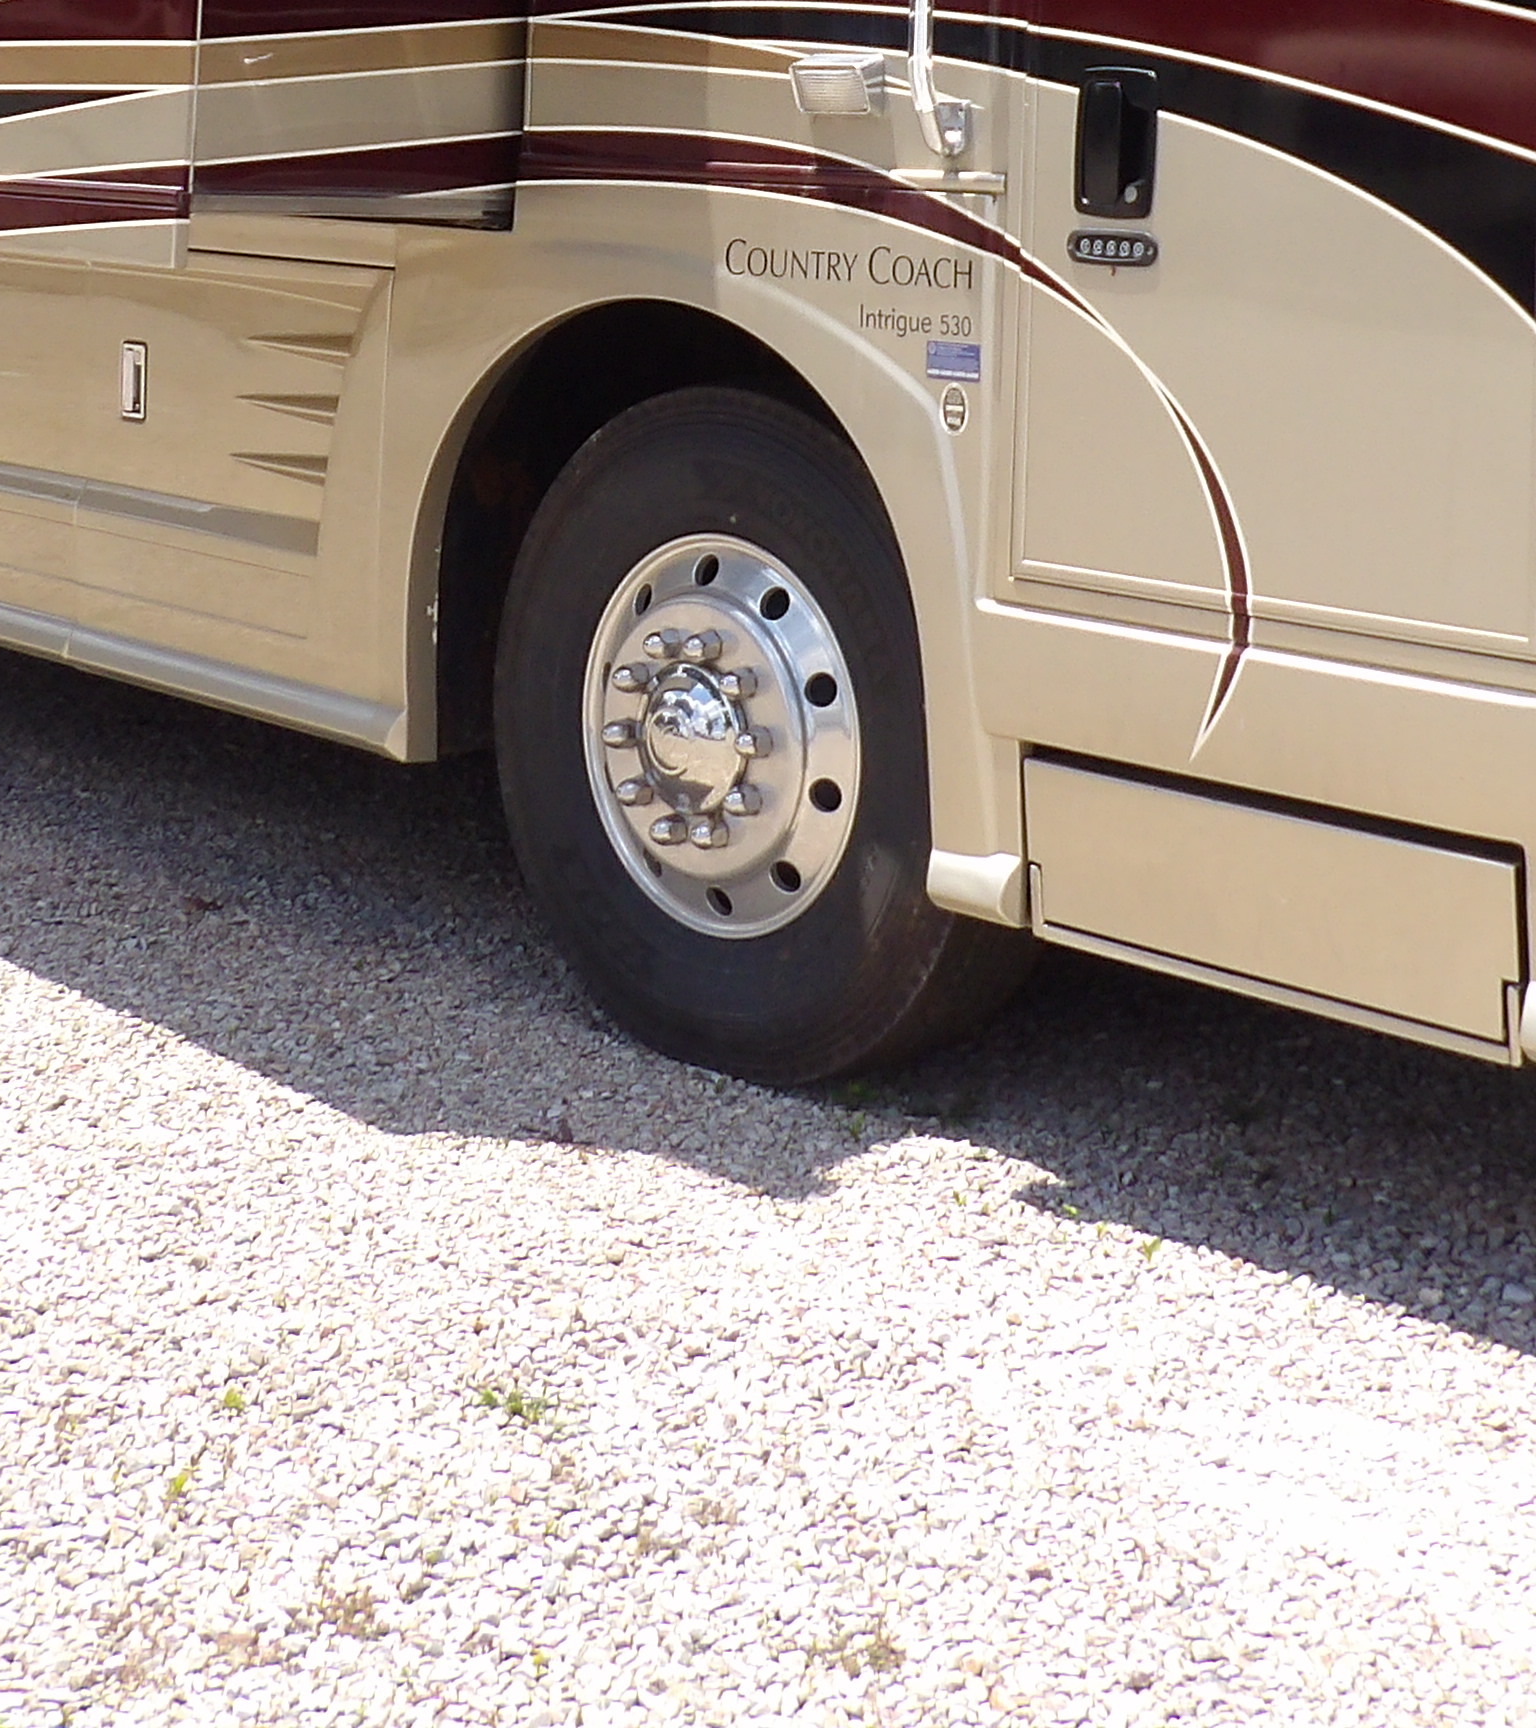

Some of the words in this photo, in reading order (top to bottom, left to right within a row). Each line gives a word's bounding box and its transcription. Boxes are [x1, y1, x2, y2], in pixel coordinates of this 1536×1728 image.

[724, 238, 858, 282] COUNTRY
[868, 246, 973, 290] COACH
[860, 304, 932, 337] Intrigue
[940, 314, 972, 337] 530
